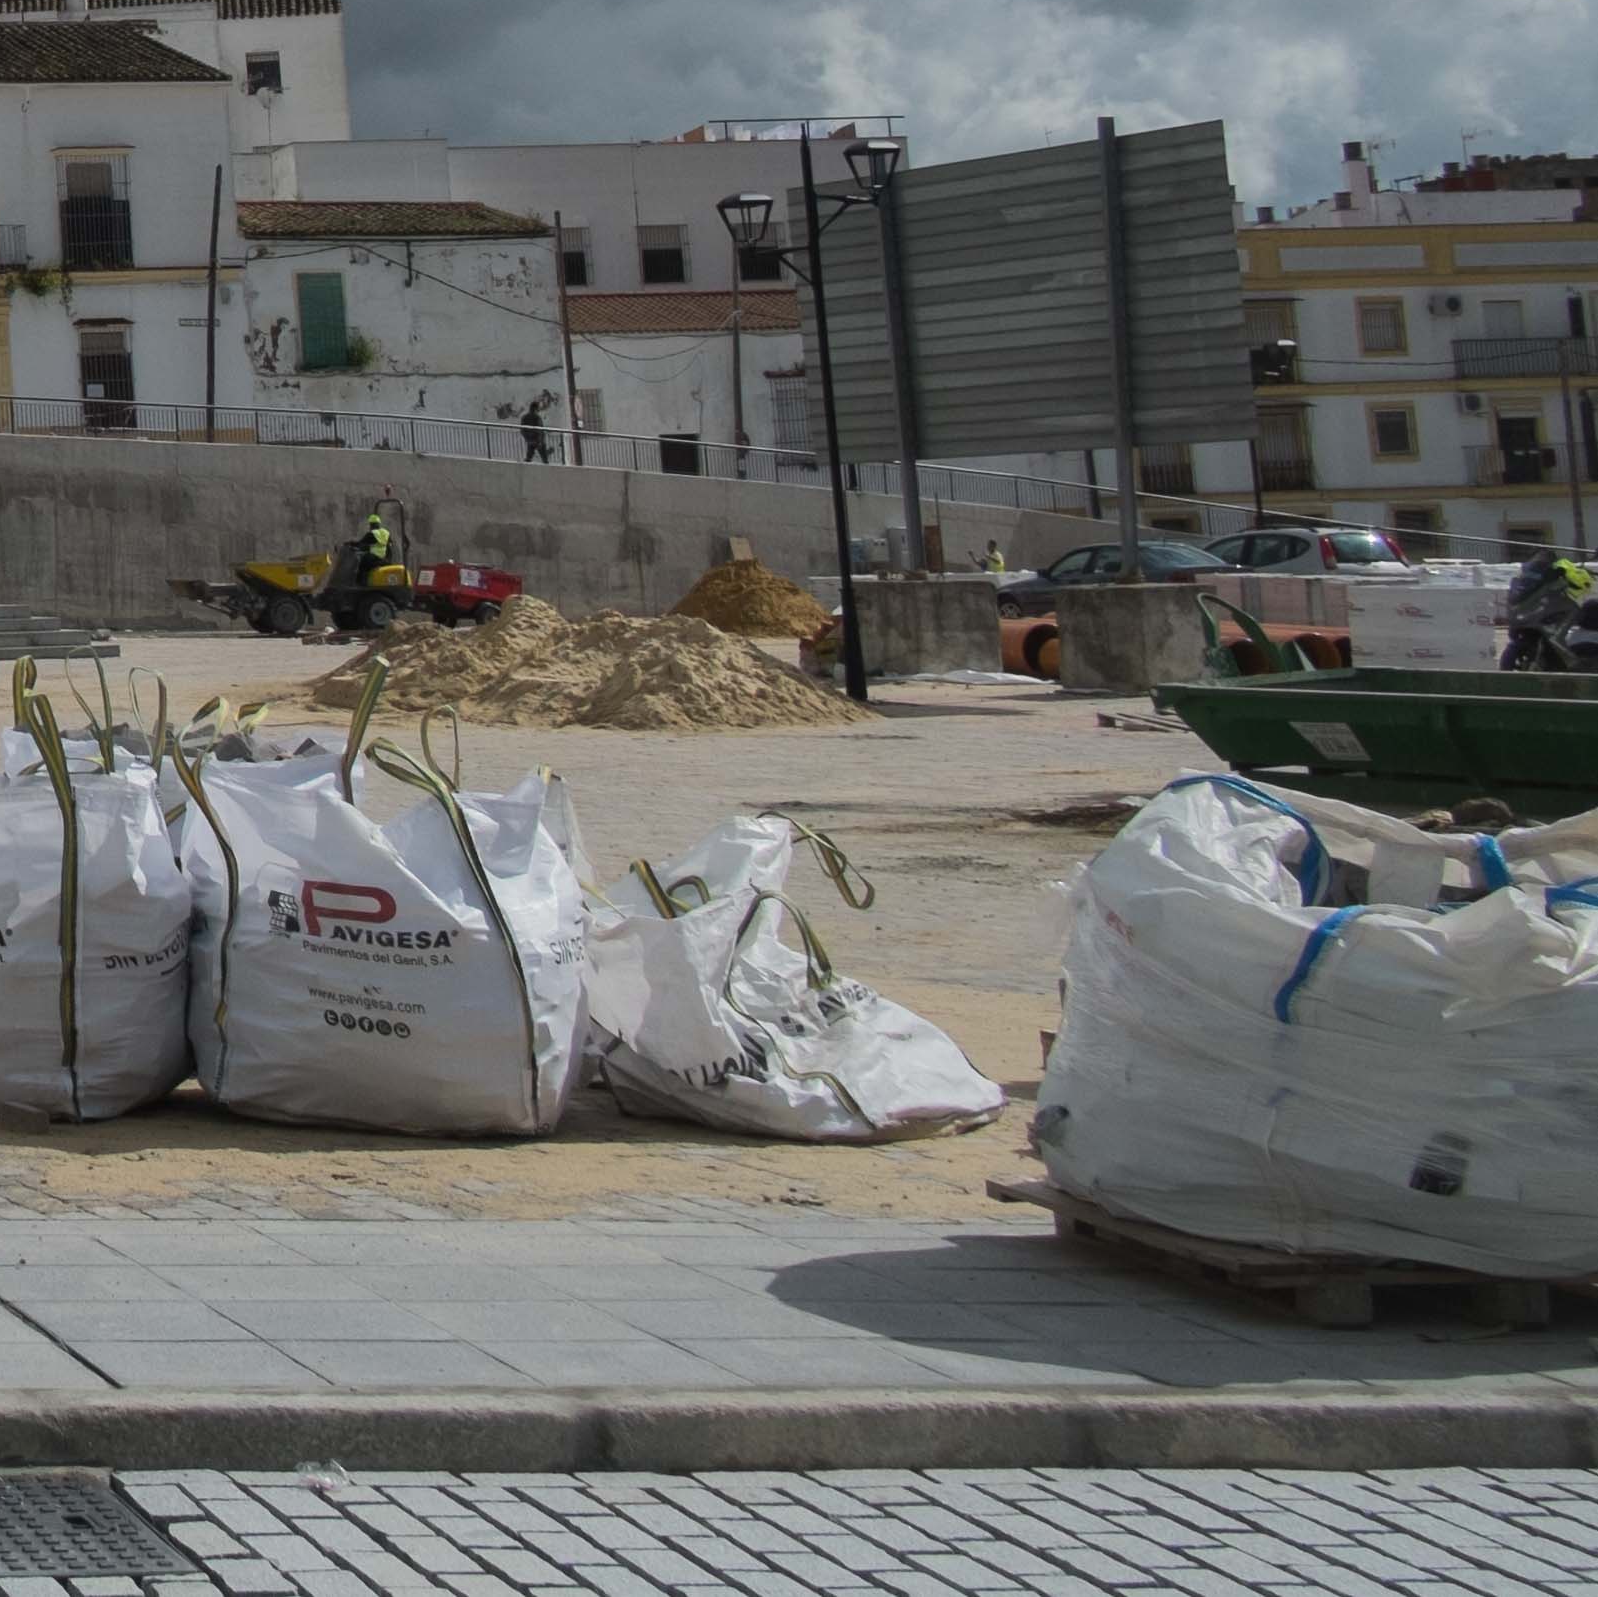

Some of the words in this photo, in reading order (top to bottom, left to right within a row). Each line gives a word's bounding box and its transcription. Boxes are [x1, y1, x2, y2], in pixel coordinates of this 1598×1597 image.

[301, 880, 452, 949] PAVIGESA
[303, 939, 370, 962] Pavimentos
[372, 952, 390, 964] del
[393, 953, 428, 967] Genil,
[430, 954, 454, 966] S.A.
[308, 985, 426, 1015] www.pavigesa.com
